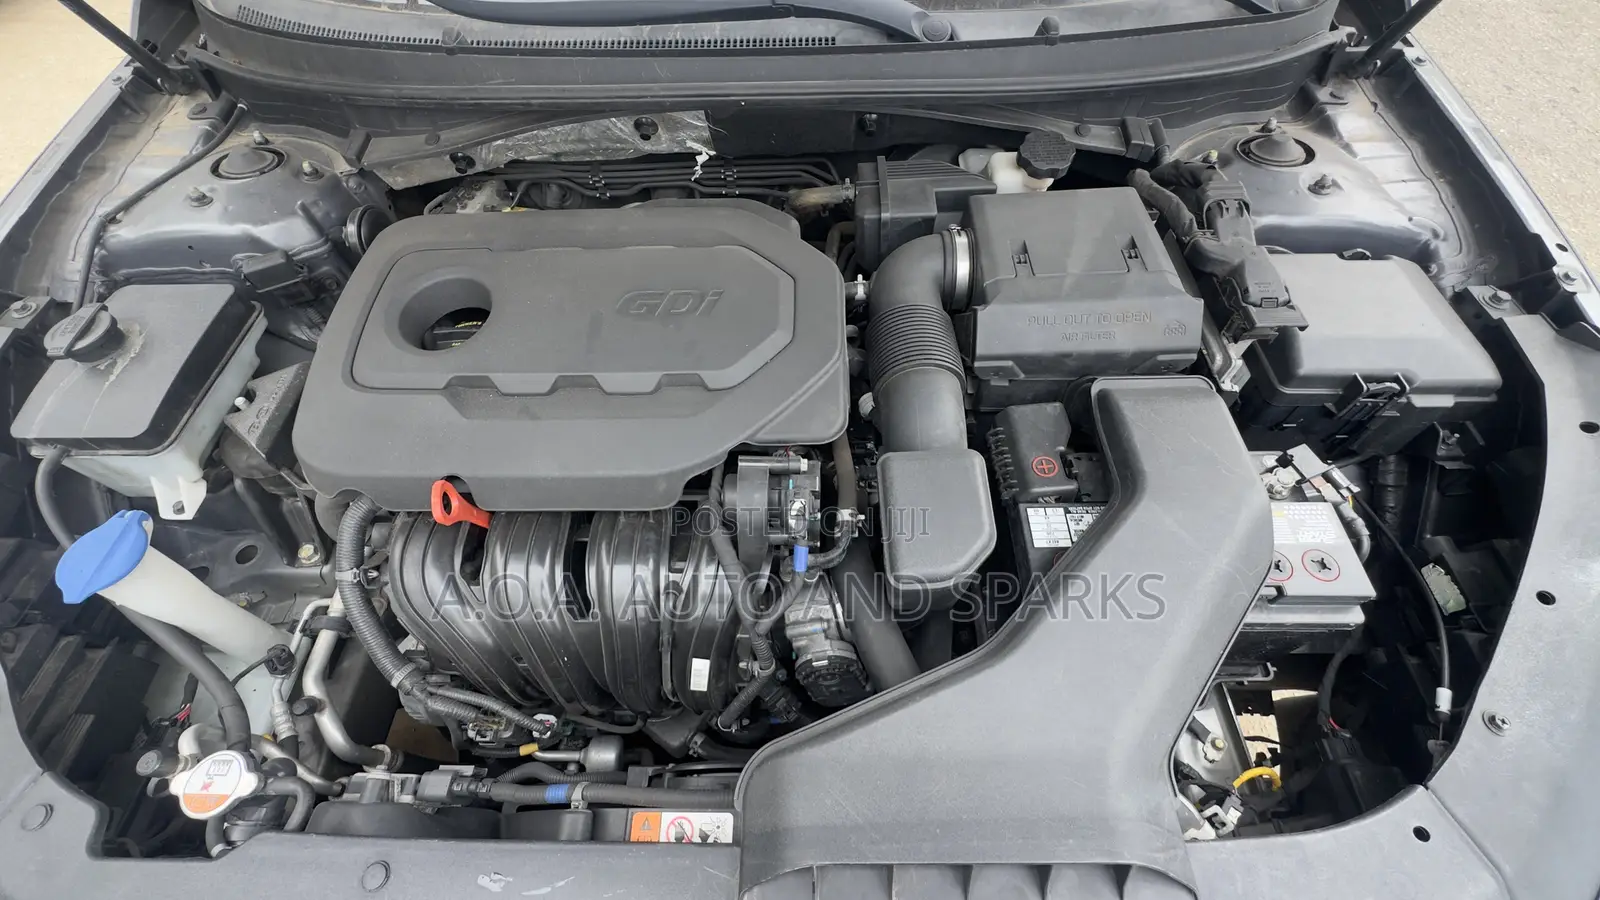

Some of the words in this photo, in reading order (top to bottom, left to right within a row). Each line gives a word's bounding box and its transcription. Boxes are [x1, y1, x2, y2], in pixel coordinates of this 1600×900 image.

[1027, 314, 1061, 327] PULL
[1063, 312, 1092, 326] OUT
[1096, 312, 1112, 325] TO
[1116, 310, 1153, 324] OPEN
[1060, 332, 1079, 342] AIR
[1081, 330, 1117, 341] FILTER
